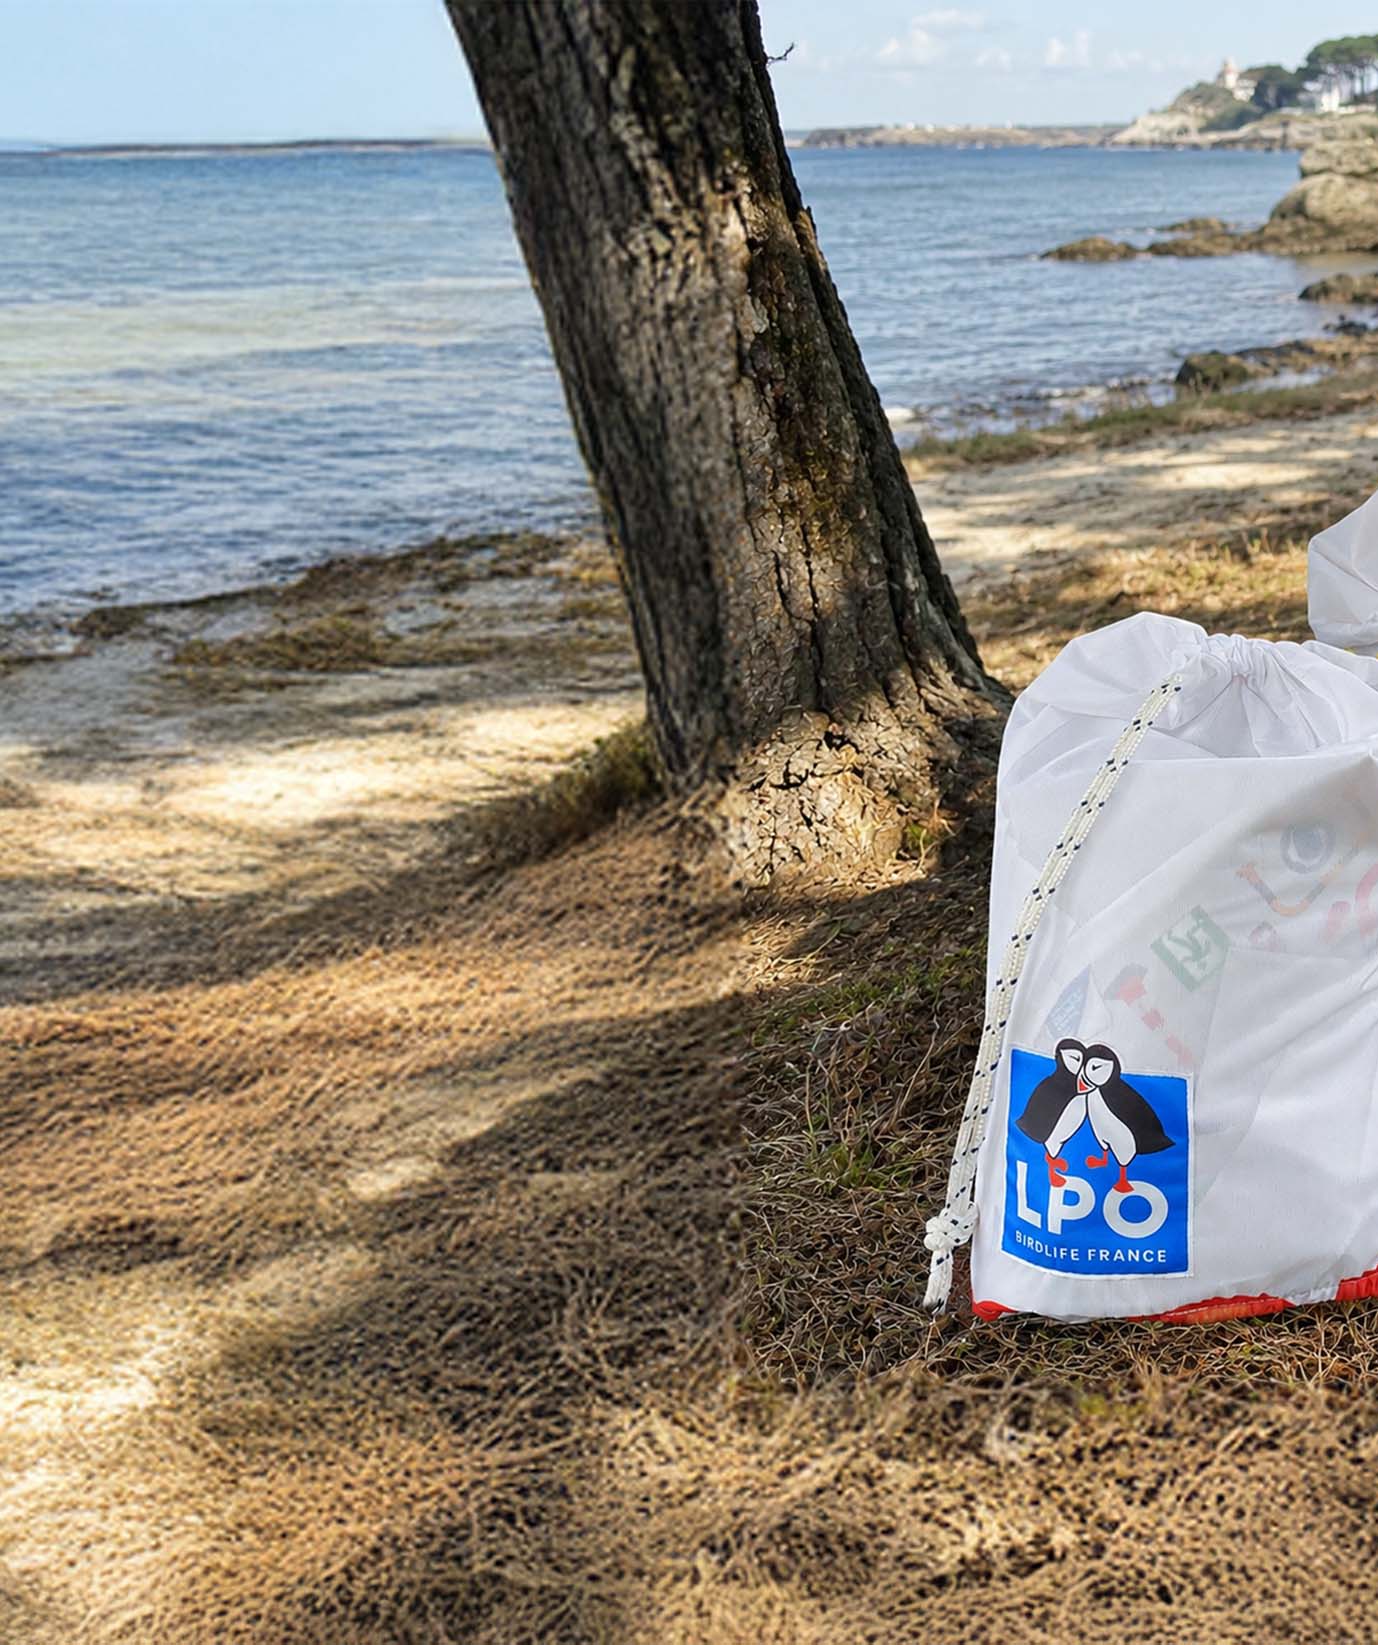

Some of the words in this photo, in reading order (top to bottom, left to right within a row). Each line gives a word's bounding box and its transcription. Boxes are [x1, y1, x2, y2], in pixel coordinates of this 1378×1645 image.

[1016, 1159, 1169, 1239] LPO
[1015, 1230, 1080, 1261] BIRDLIFE
[1088, 1248, 1167, 1263] FRANCE
